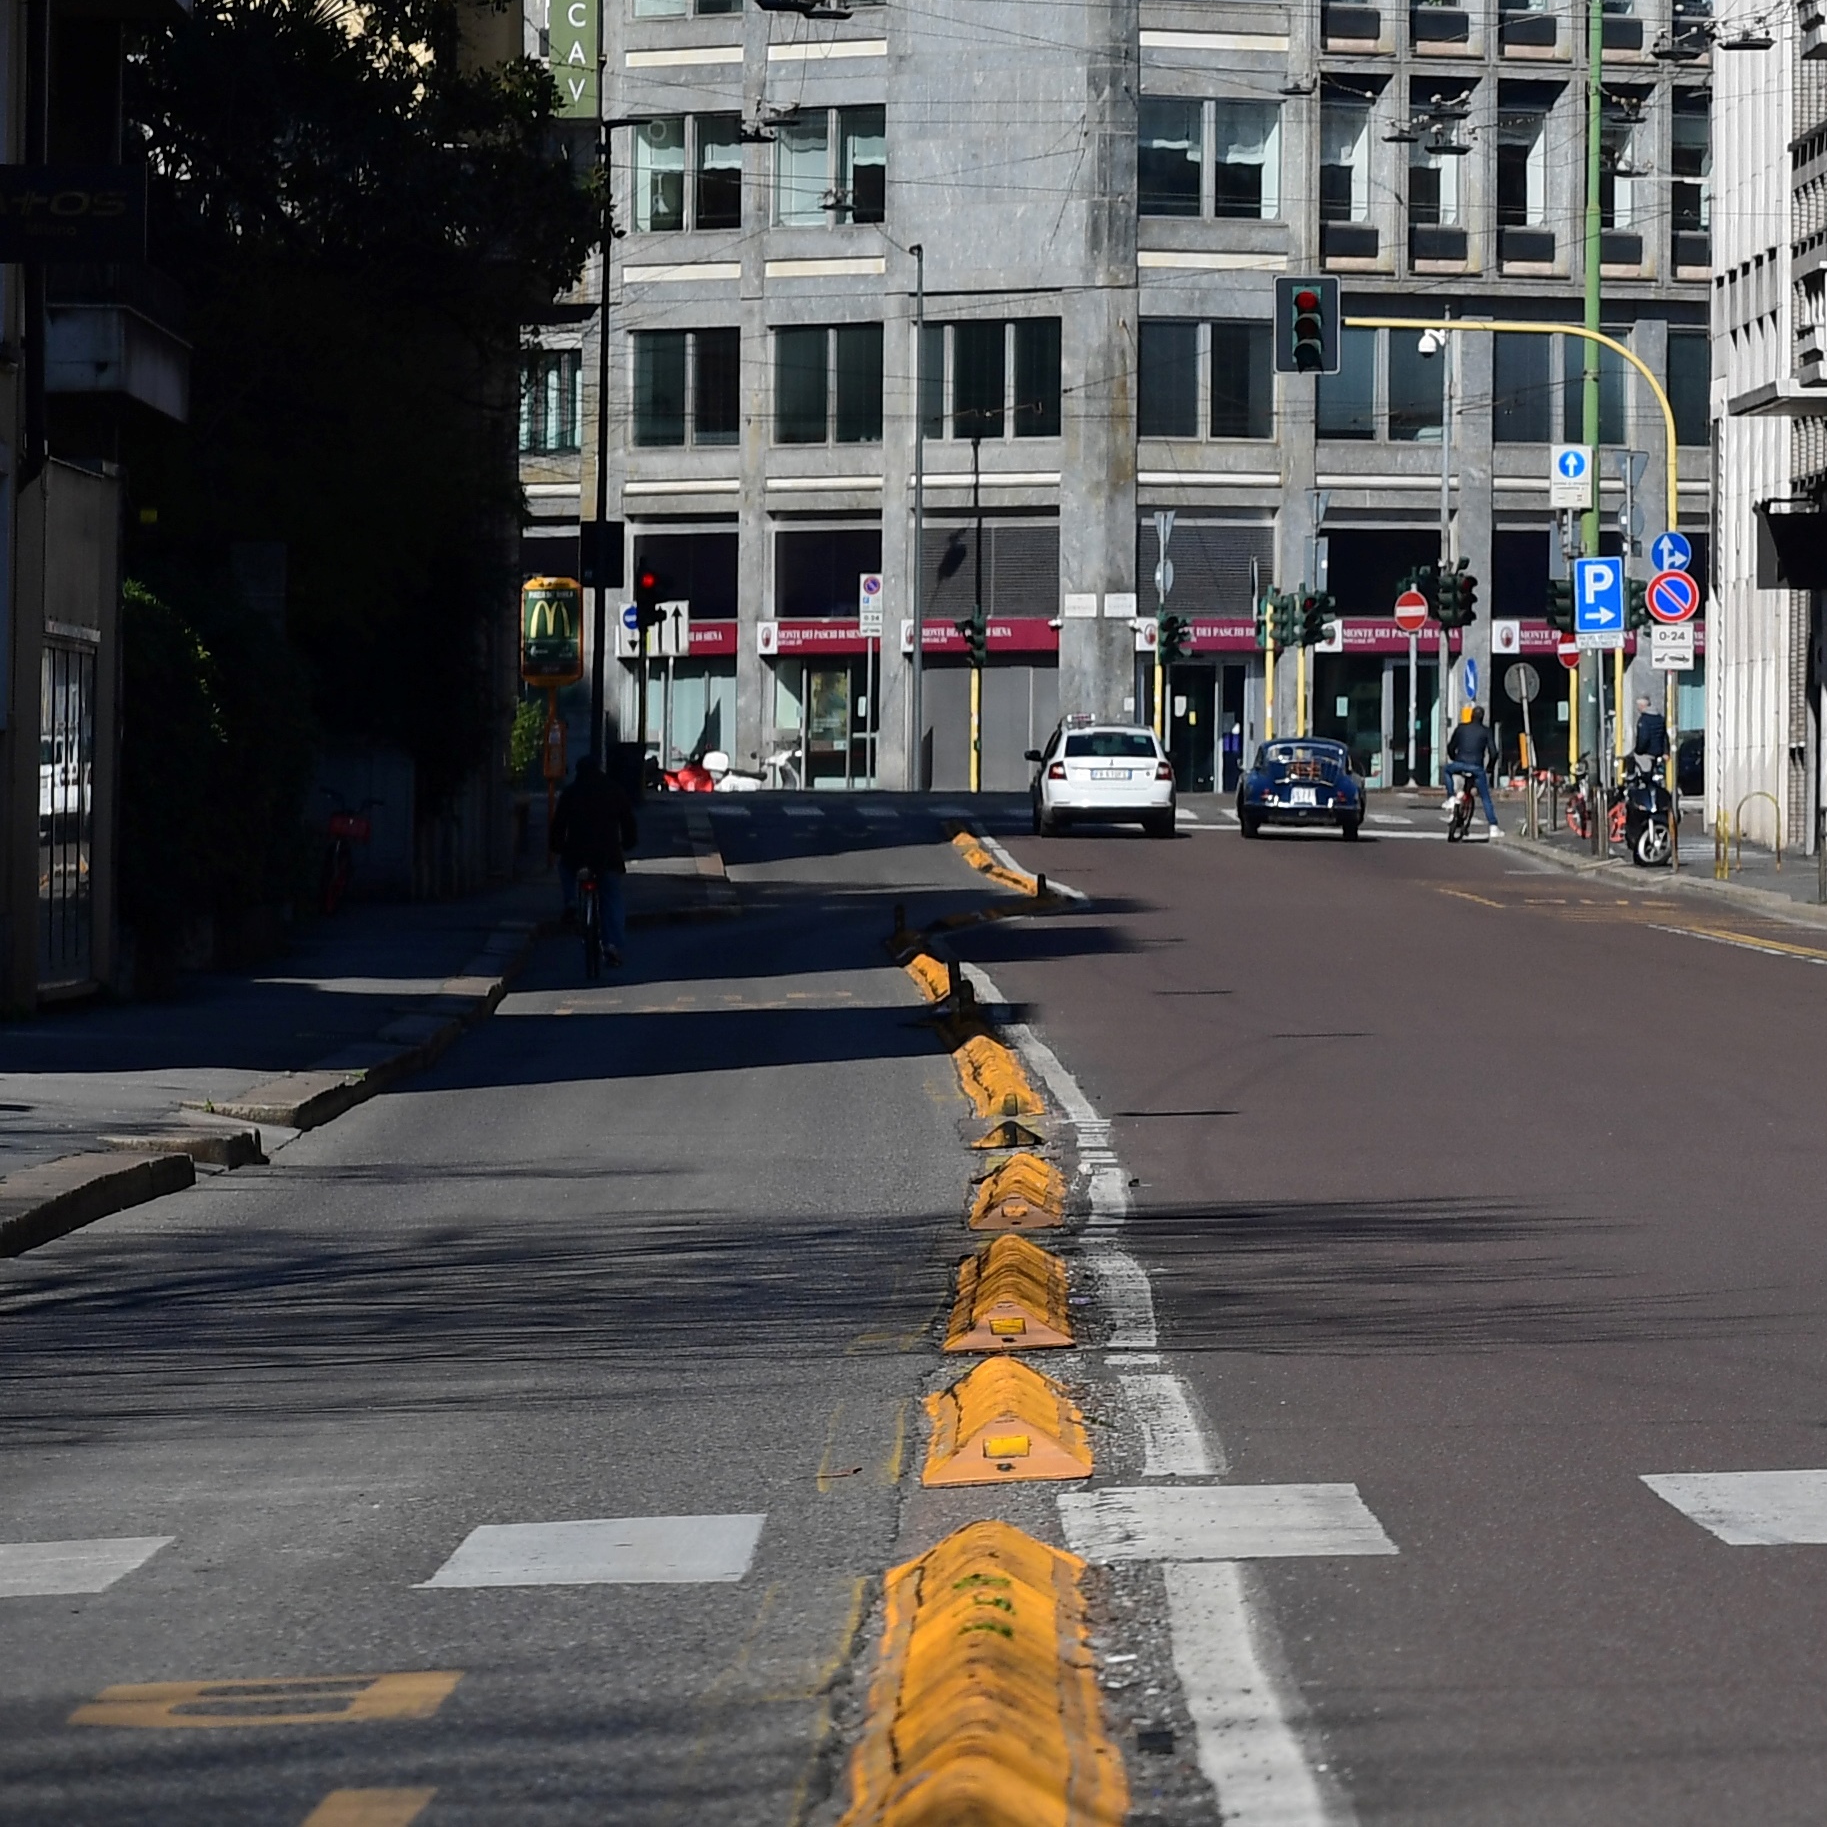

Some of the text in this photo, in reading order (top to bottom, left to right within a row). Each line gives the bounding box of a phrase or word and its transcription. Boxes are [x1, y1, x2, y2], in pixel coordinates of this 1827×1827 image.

[1584, 564, 1614, 604] P
[1213, 626, 1243, 637] PASCHI
[1343, 628, 1373, 638] MONTE
[1375, 628, 1390, 638] DEI
[1520, 630, 1549, 640] MONTE
[1659, 631, 1686, 641] 0-24
